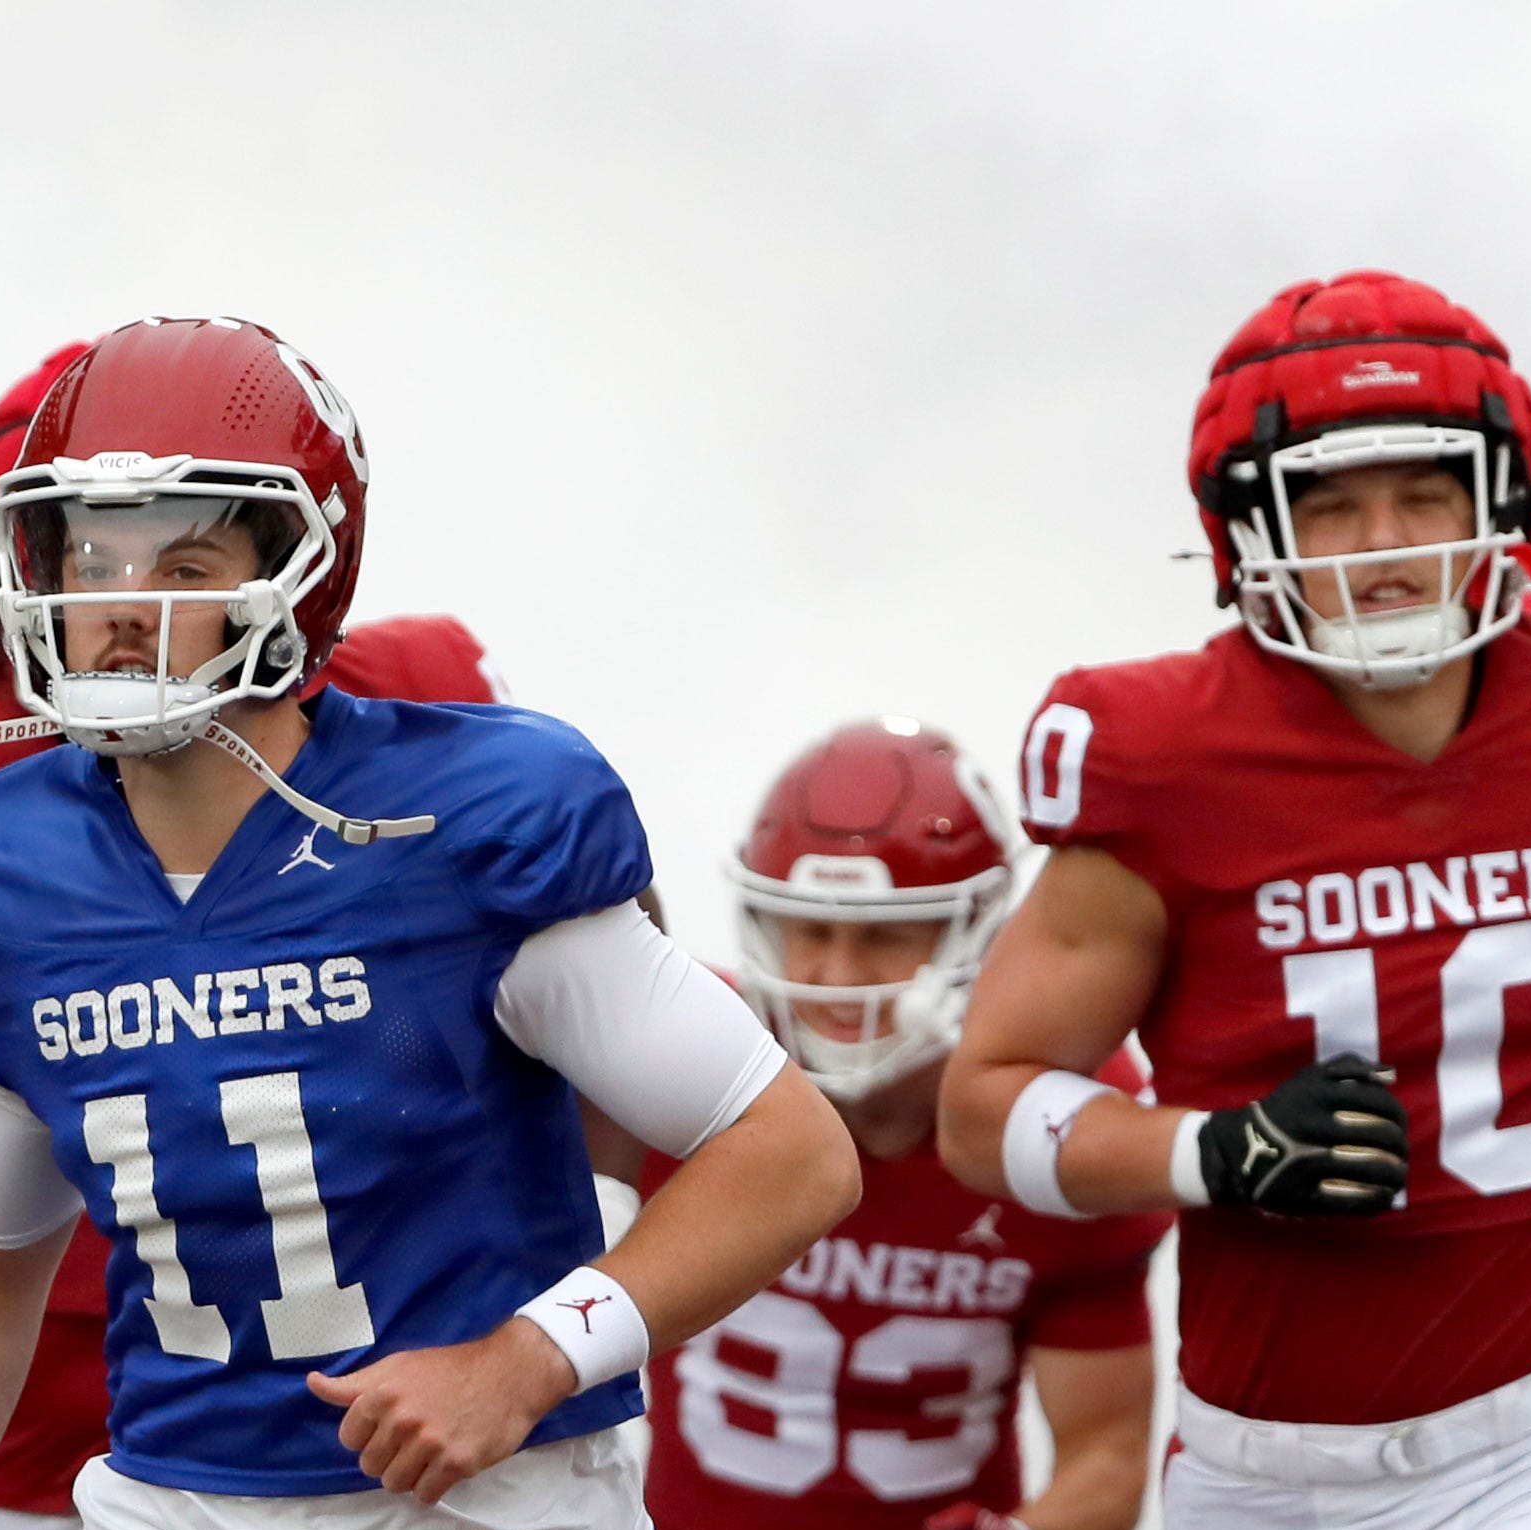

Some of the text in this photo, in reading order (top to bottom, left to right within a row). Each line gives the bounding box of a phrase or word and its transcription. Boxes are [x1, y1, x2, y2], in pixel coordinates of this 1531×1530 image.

[98, 456, 142, 469] VICIS
[32, 956, 372, 1062] SOONERS
[82, 1071, 375, 1365] 11
[780, 1236, 1034, 1311] ONERS
[674, 1290, 1015, 1502] 83
